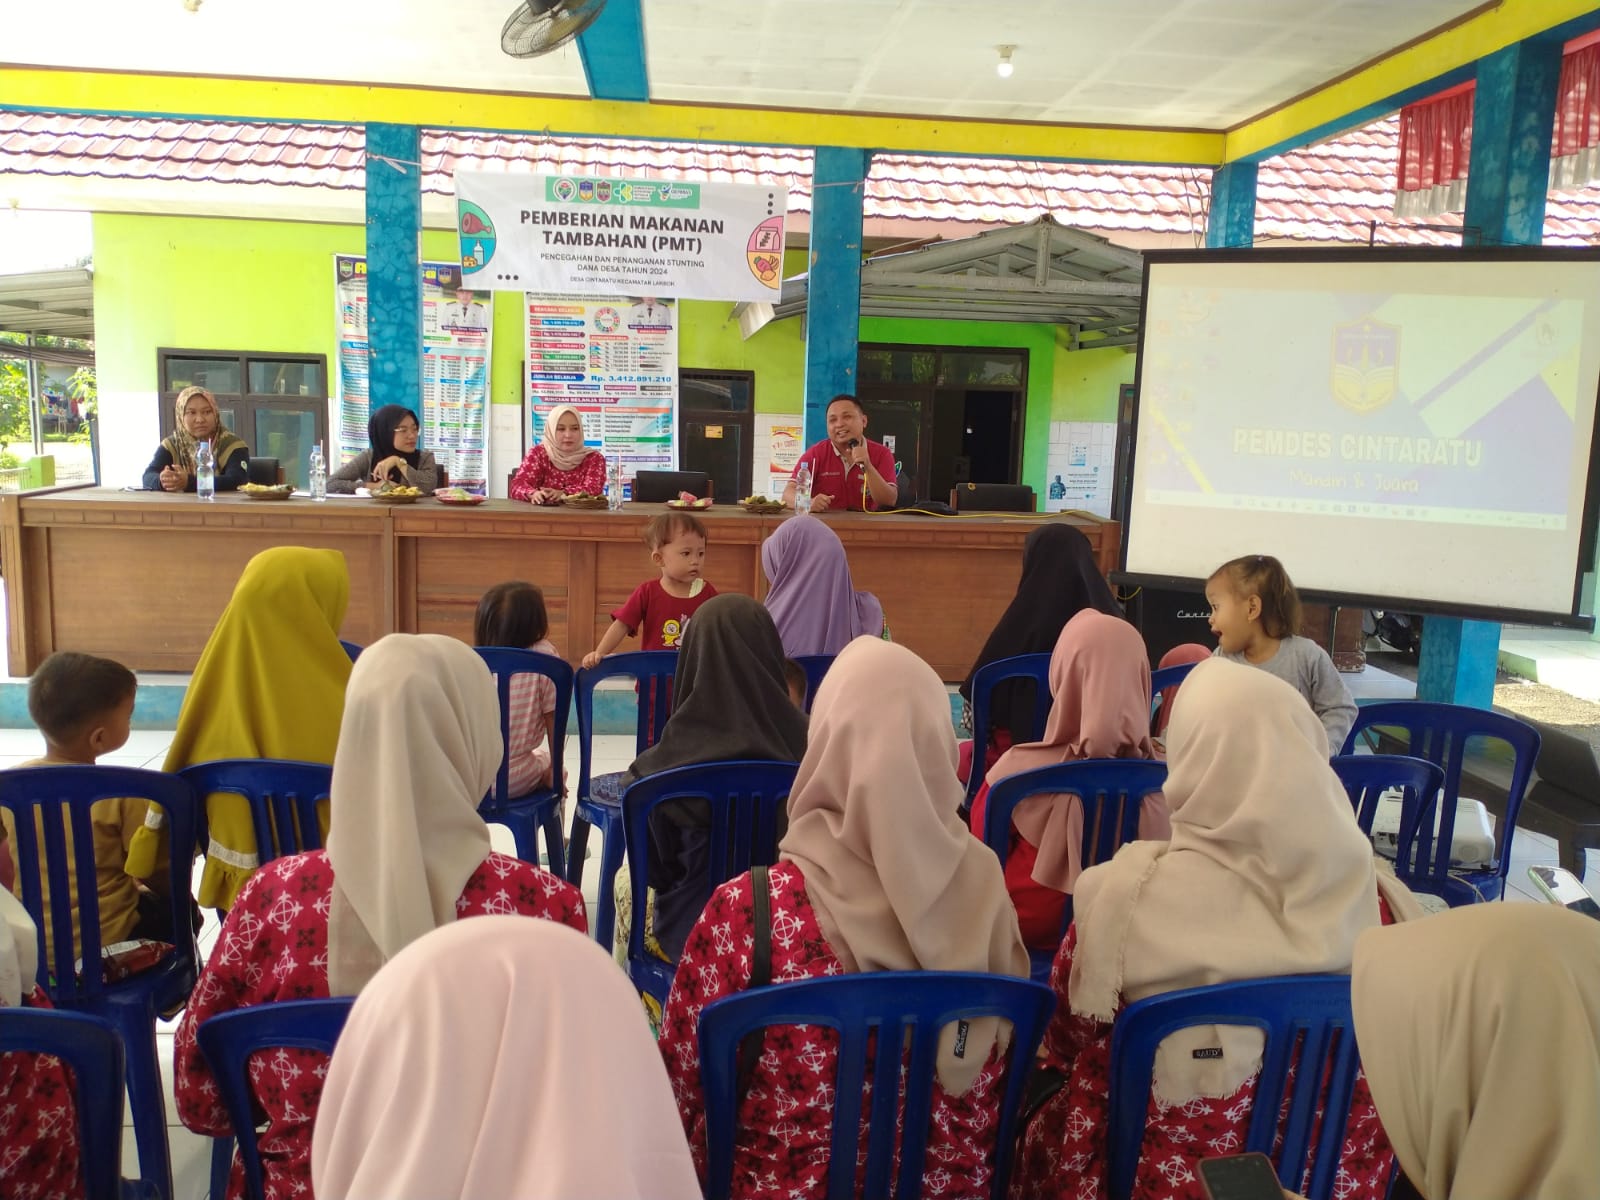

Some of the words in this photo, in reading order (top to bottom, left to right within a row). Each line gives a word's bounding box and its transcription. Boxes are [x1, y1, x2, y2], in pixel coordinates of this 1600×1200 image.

[520, 210, 624, 229] PEMBERIAN
[629, 215, 724, 234] MAKANAN
[542, 230, 647, 249] TAMBAHAN
[652, 236, 702, 255] (PMT)
[540, 253, 593, 262] PENCEGAHAN
[594, 255, 611, 263] DAN
[612, 256, 665, 266] PENANGANAN
[666, 259, 705, 268] STUNTING
[600, 265, 621, 273] DESA
[622, 266, 648, 274] TAHUN
[1233, 428, 1332, 458] PEMDES
[1340, 433, 1483, 467] CINTARATU
